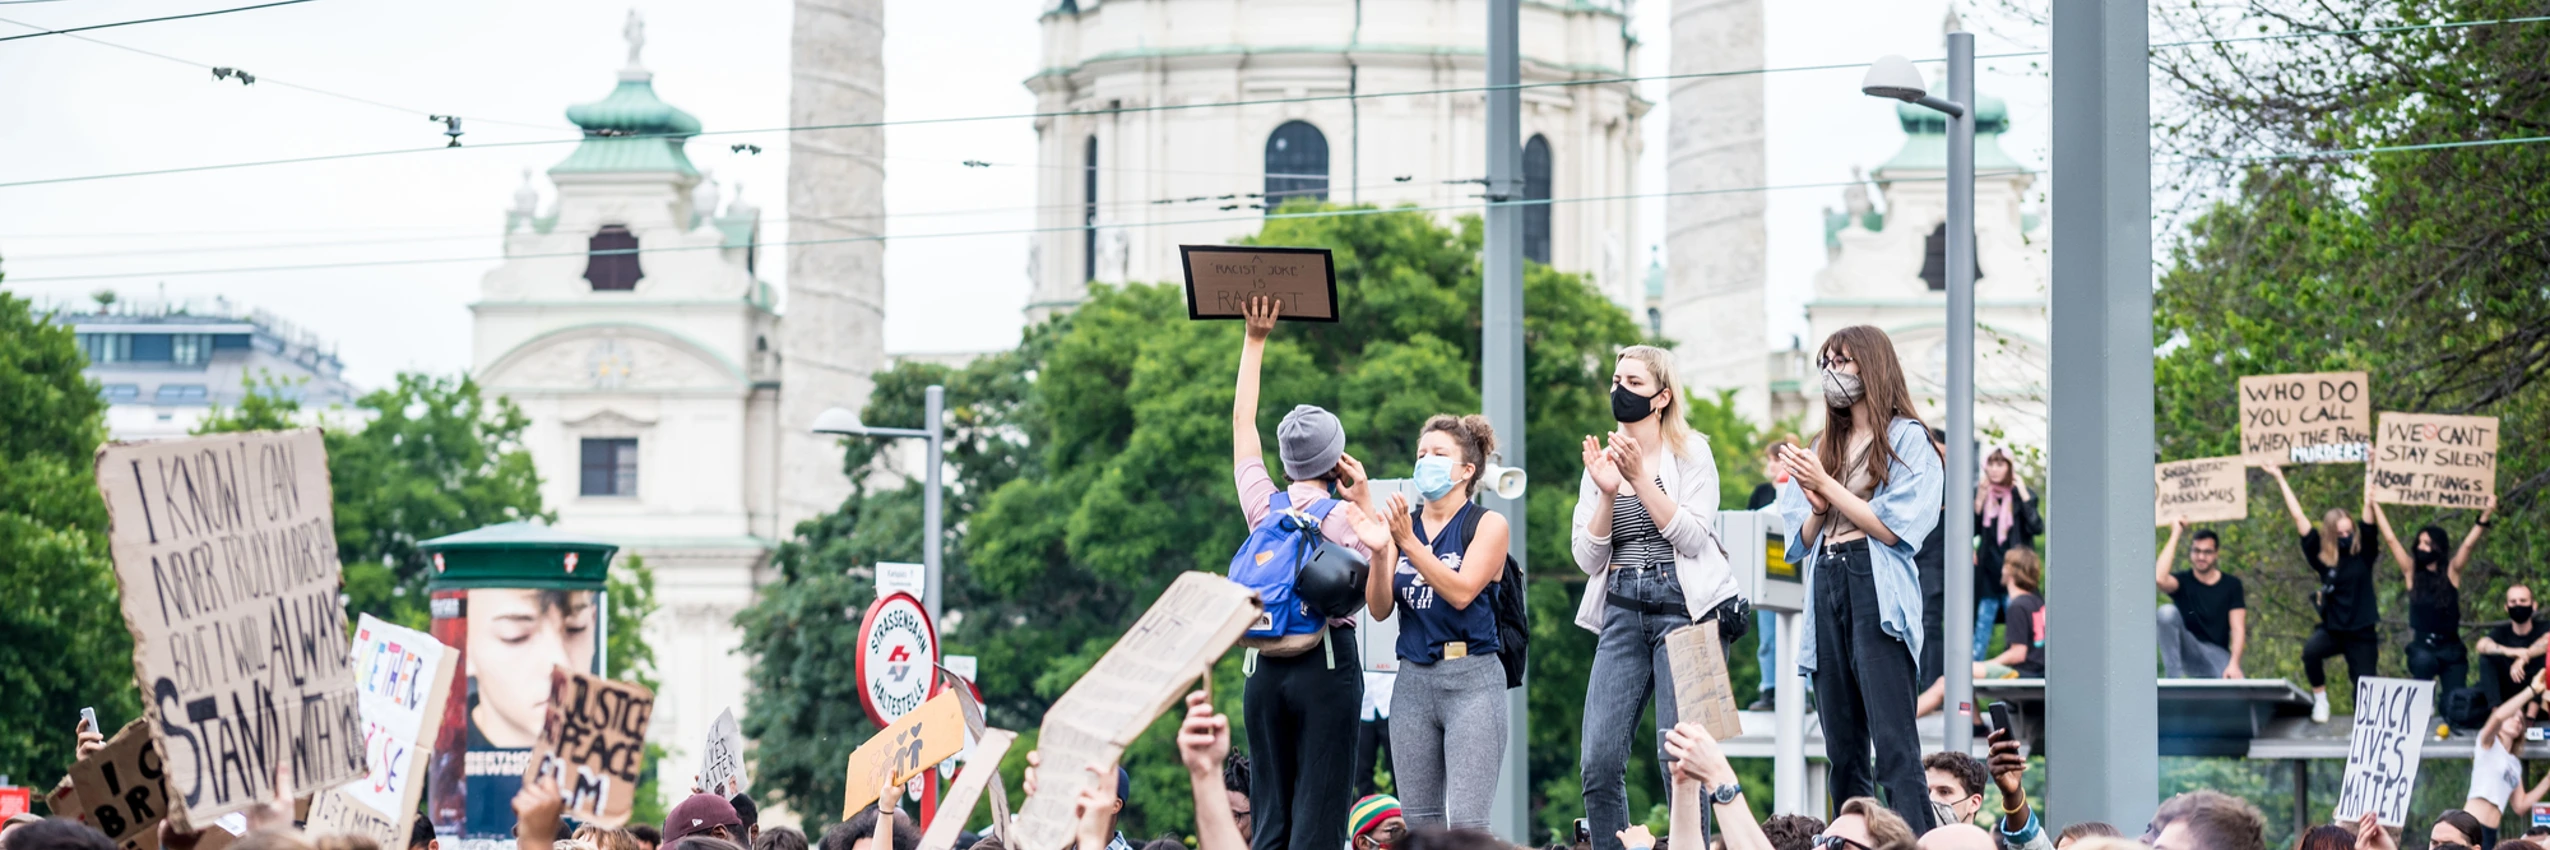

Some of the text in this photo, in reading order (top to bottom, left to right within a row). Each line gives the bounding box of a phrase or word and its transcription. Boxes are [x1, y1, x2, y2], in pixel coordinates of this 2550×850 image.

[1251, 254, 1263, 264] A
[1252, 279, 1267, 289] IS
[2245, 380, 2359, 403] WHO DO
[2246, 403, 2354, 429] YOU CALL
[2245, 432, 2294, 453] WHEN
[2298, 428, 2329, 447] THE
[2387, 422, 2425, 442] WE
[2380, 444, 2496, 470] STAY SILENT
[130, 458, 158, 545] I
[158, 448, 243, 540] KNOW
[260, 439, 300, 522] CAN
[2373, 468, 2483, 492] ABOUT THINGS
[2160, 486, 2236, 508] RASSISMUS
[2396, 488, 2434, 502] THAT
[151, 541, 228, 628] NEVER
[220, 529, 276, 604] TRULY
[1401, 586, 1415, 600] UP
[1416, 599, 1432, 609] SKY
[871, 609, 928, 655] STRASSENBAHN
[169, 625, 213, 695] BUT
[214, 620, 229, 684] I
[226, 615, 267, 680] WILL
[566, 675, 653, 742] JUSTICE
[872, 678, 925, 717] HALTESTELLE
[2357, 681, 2418, 735] BLACK
[154, 677, 280, 809] STAND
[284, 690, 335, 790] WITH
[556, 722, 641, 784] PEACE
[2350, 727, 2406, 783] LIVES
[464, 751, 532, 763] BEETHO
[464, 763, 524, 776] BEWEG
[101, 760, 121, 797] I
[95, 777, 170, 838] BR
[2340, 771, 2408, 824] MATTER
